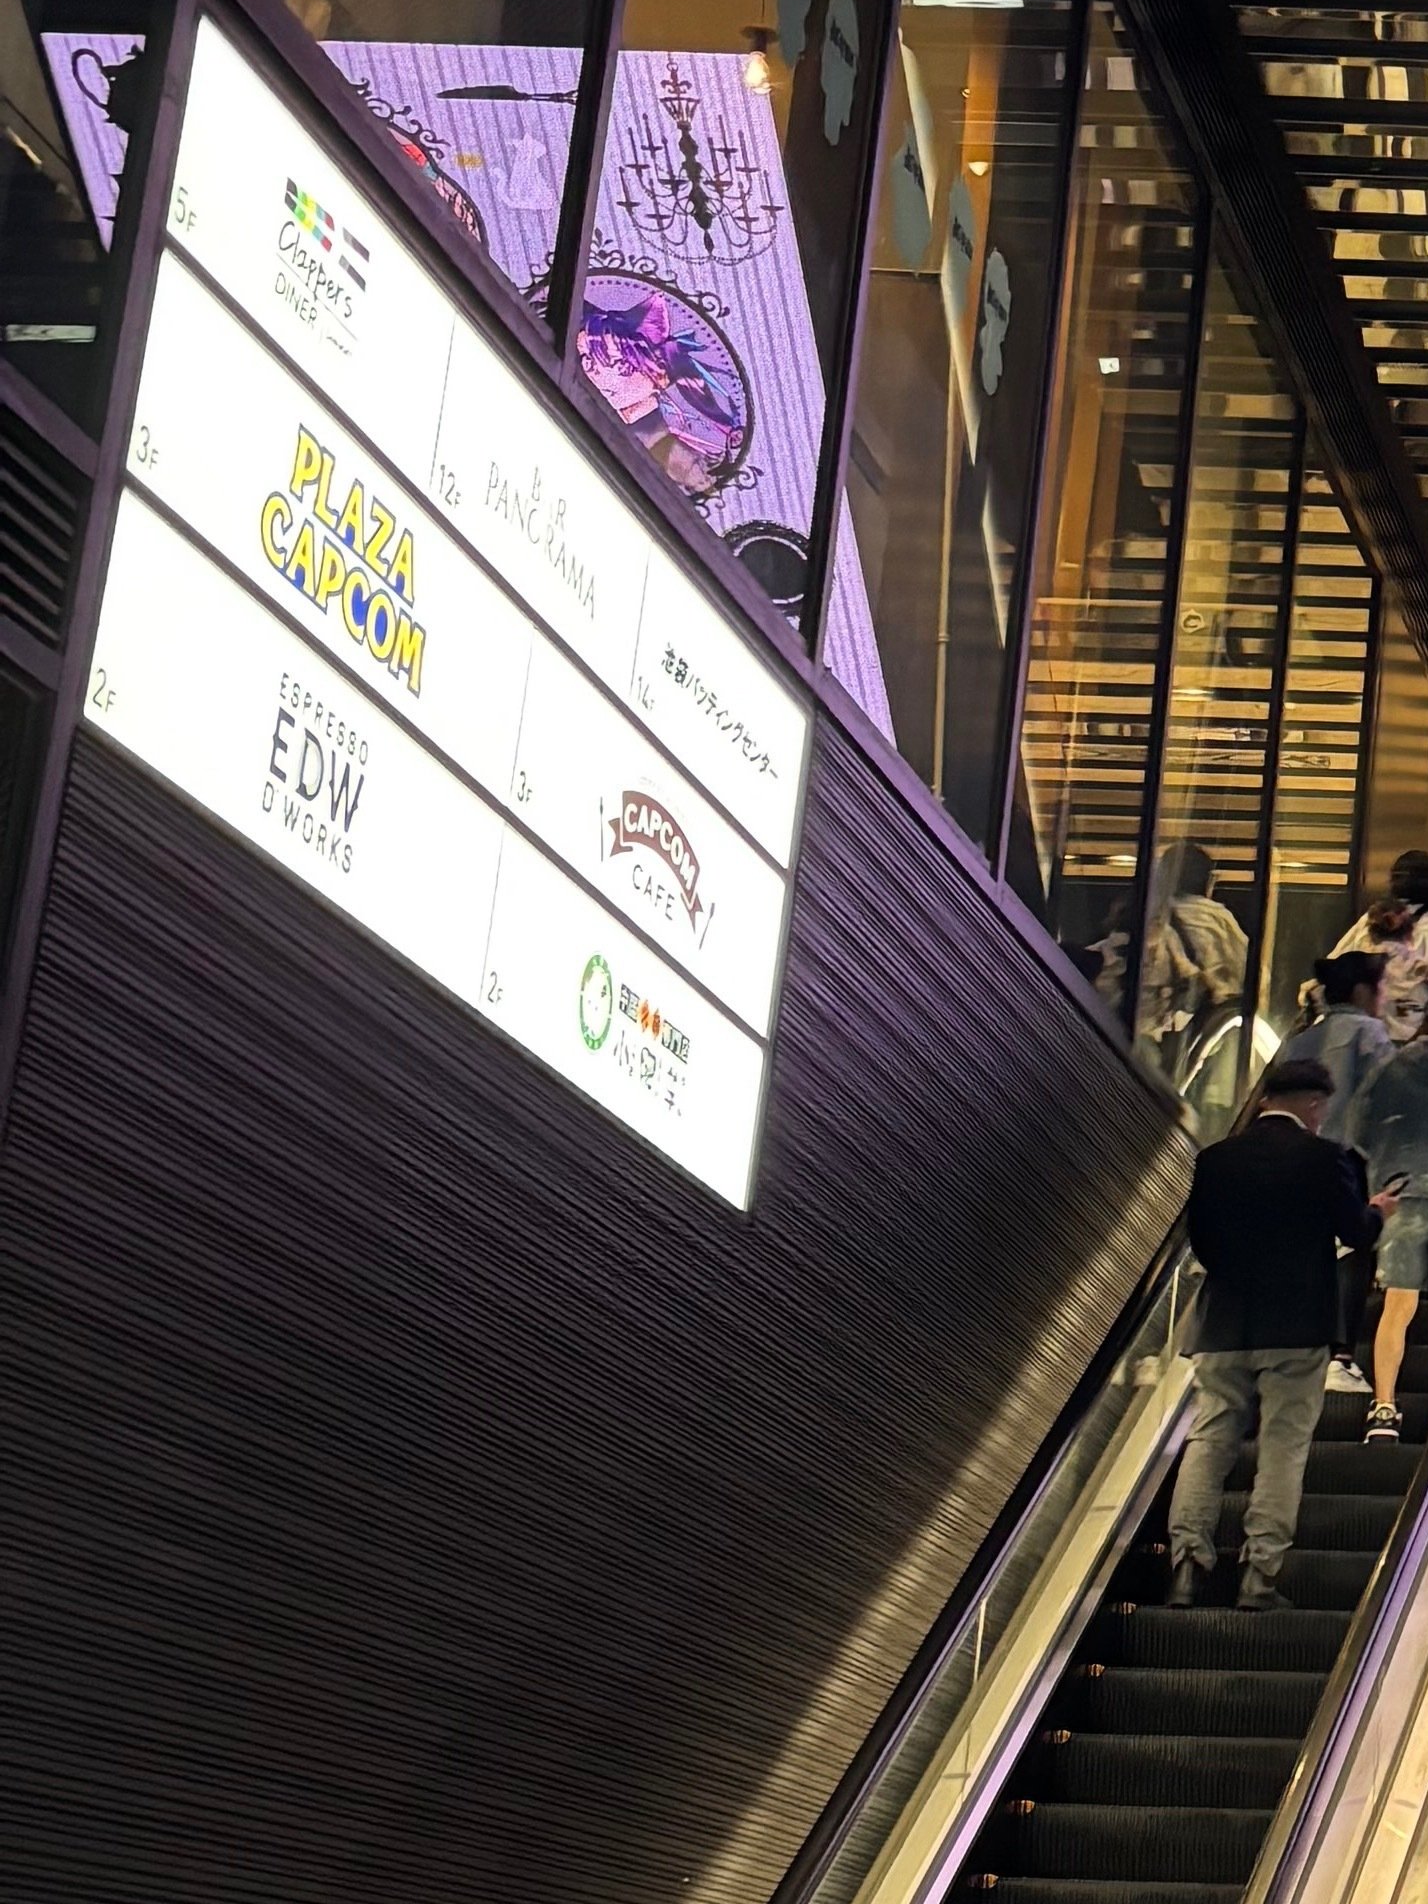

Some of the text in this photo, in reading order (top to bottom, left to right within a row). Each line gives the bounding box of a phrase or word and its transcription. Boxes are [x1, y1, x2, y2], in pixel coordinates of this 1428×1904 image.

[275, 272, 318, 330] DINER
[278, 221, 353, 318] Clappers
[136, 425, 159, 470] 3F
[290, 423, 414, 608] PLAZA
[261, 491, 426, 698] CAPCOM
[92, 668, 116, 712] 2F
[279, 672, 369, 765] ESPRESSO
[269, 706, 364, 833] EDW
[623, 802, 696, 889] CAPCOM
